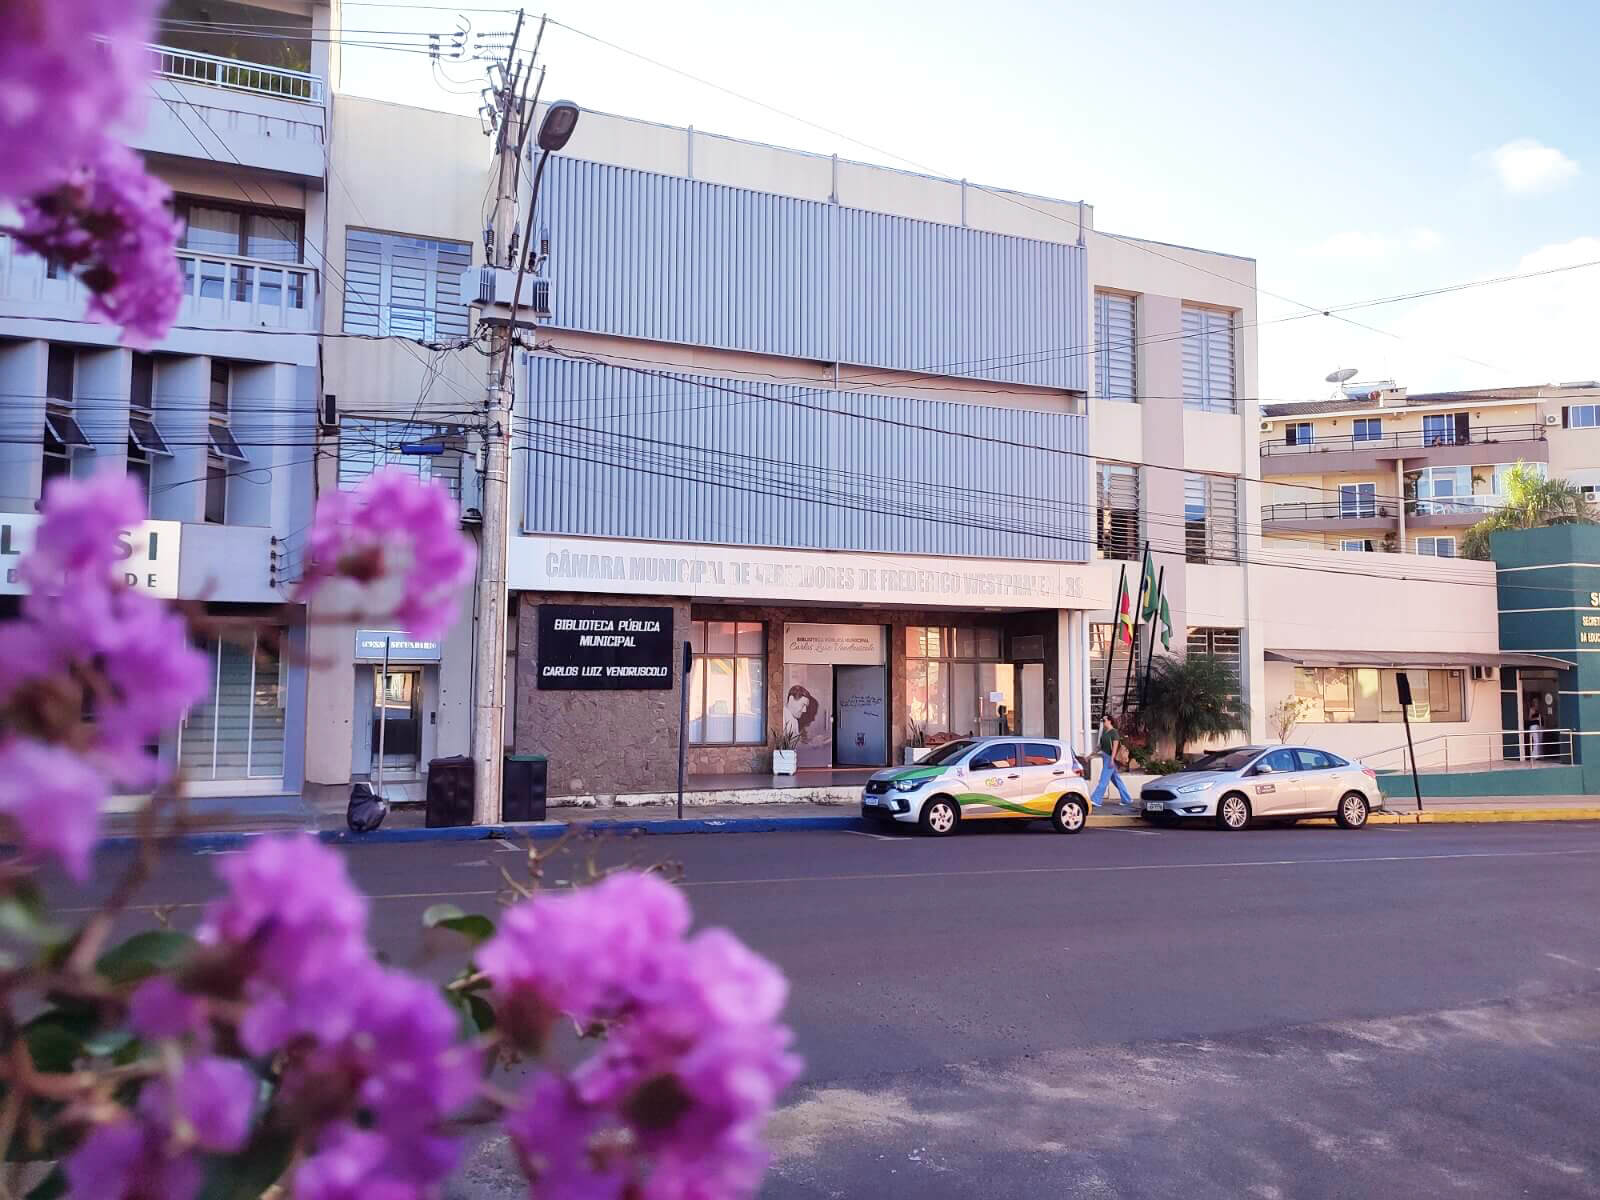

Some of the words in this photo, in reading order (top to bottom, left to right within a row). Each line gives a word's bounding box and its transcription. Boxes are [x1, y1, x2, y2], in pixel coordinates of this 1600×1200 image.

[545, 547, 626, 580] CÂMARA
[629, 556, 727, 585] MUNICIPAL
[754, 563, 855, 590] VEREDORES
[858, 567, 877, 591] DE
[880, 568, 960, 594] FREDERICO
[554, 618, 614, 631] BIBLIOTECA
[618, 618, 661, 632] PÚBLICA
[579, 635, 637, 648] MUNICIPAL
[542, 666, 579, 677] CARLOS
[581, 666, 602, 677] LUIZ
[606, 666, 668, 677] VENDRUSCOLO
